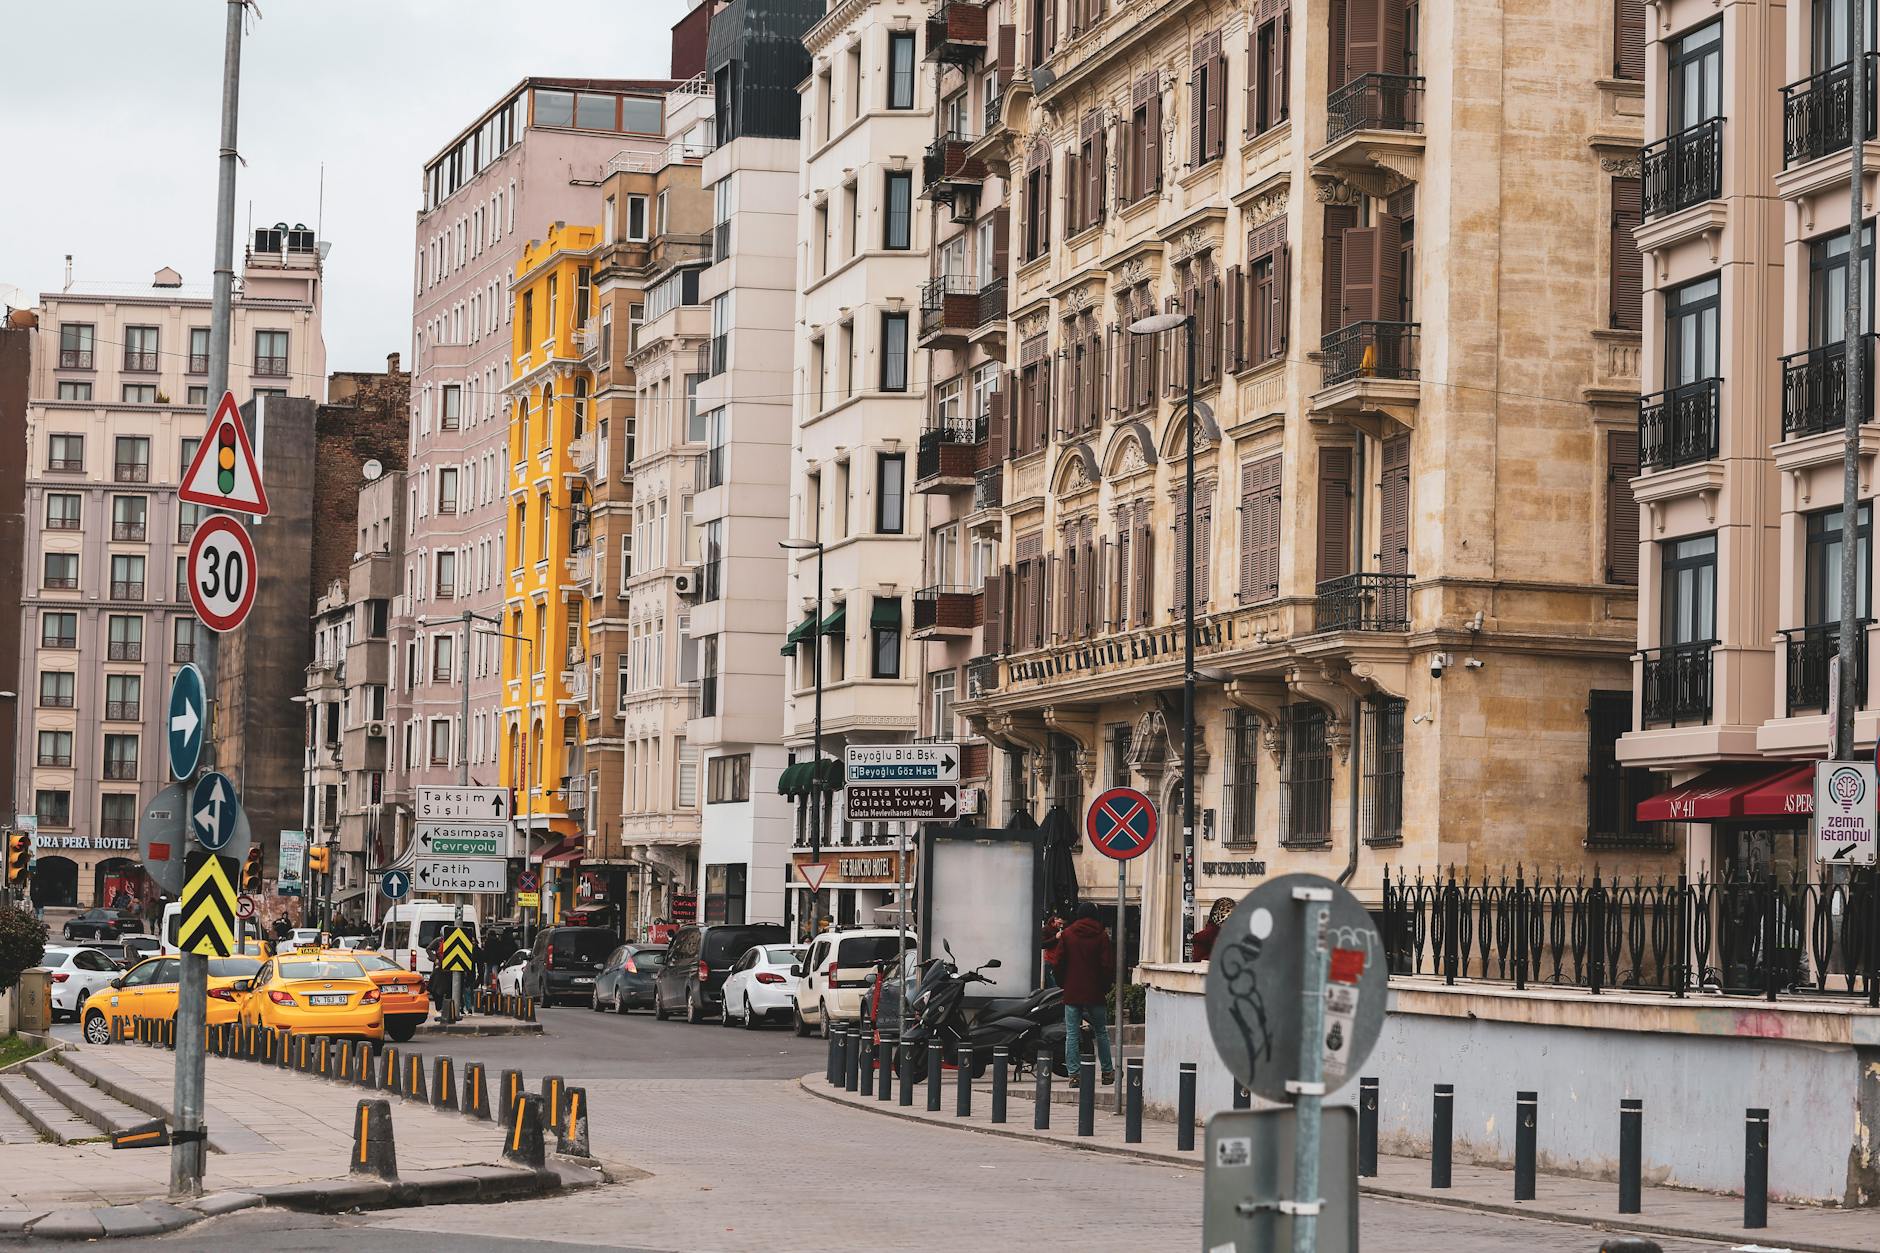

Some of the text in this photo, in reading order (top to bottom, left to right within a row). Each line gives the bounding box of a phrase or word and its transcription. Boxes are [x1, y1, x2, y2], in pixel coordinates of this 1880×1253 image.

[201, 545, 243, 603] 30
[850, 749, 938, 763] Beyoğlu Bld. Bşk.
[859, 766, 895, 778] Beyoğlu
[897, 766, 913, 776] Göz
[916, 766, 937, 776] Hast.
[424, 791, 485, 802] Taksim
[852, 788, 931, 797] Galata Kulesi
[850, 798, 933, 808] (Galata Tower)
[423, 804, 469, 816] Şişli
[850, 808, 869, 817] Galata
[870, 808, 911, 817] Mevlevihanesi
[1828, 817, 1864, 828] zemin
[433, 827, 504, 839] Kasımpaşa
[1821, 827, 1870, 841] istanbul
[62, 836, 90, 849] PERA
[94, 837, 130, 849] HOTEL
[433, 841, 495, 853] Çevreyolu
[432, 863, 470, 874] Fatih
[839, 858, 848, 876] THE
[872, 857, 889, 876] HOTEL
[432, 877, 499, 889] Unkapanı
